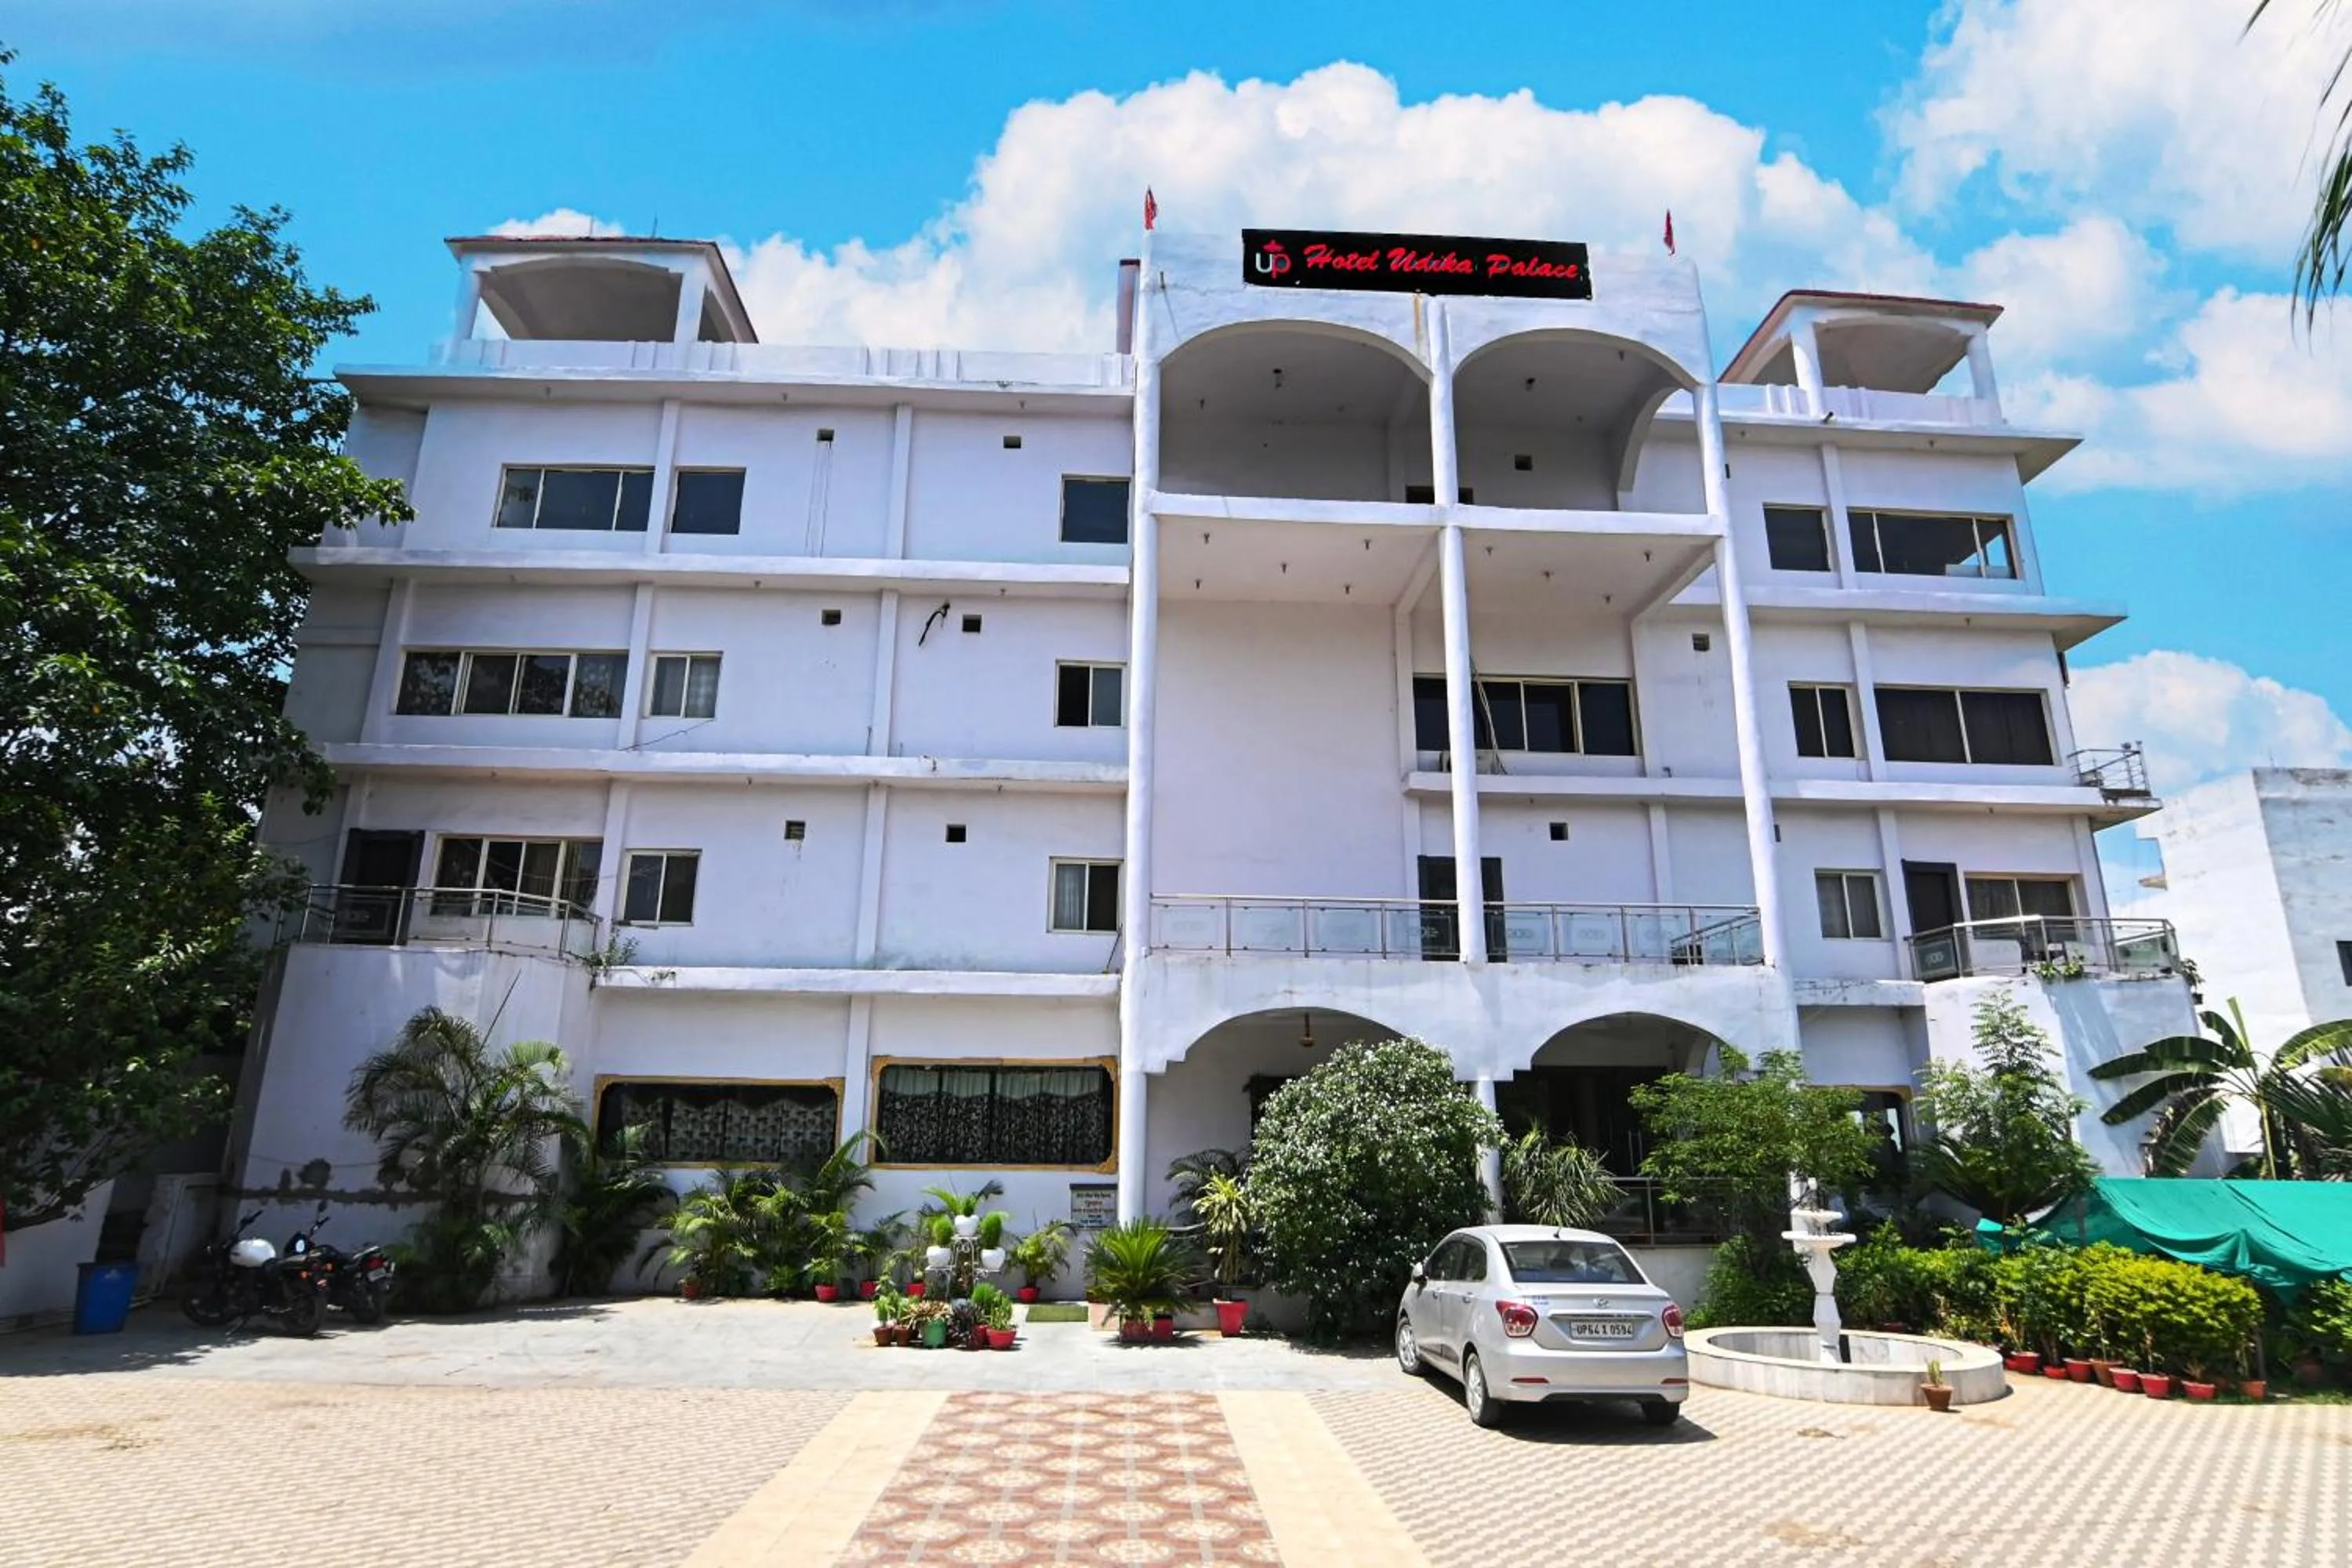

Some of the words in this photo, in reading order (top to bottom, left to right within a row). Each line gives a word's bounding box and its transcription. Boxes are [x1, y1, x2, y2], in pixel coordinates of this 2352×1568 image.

[1303, 243, 1381, 271] Hotel
[1386, 246, 1473, 274] Udika
[1486, 253, 1579, 279] Palace
